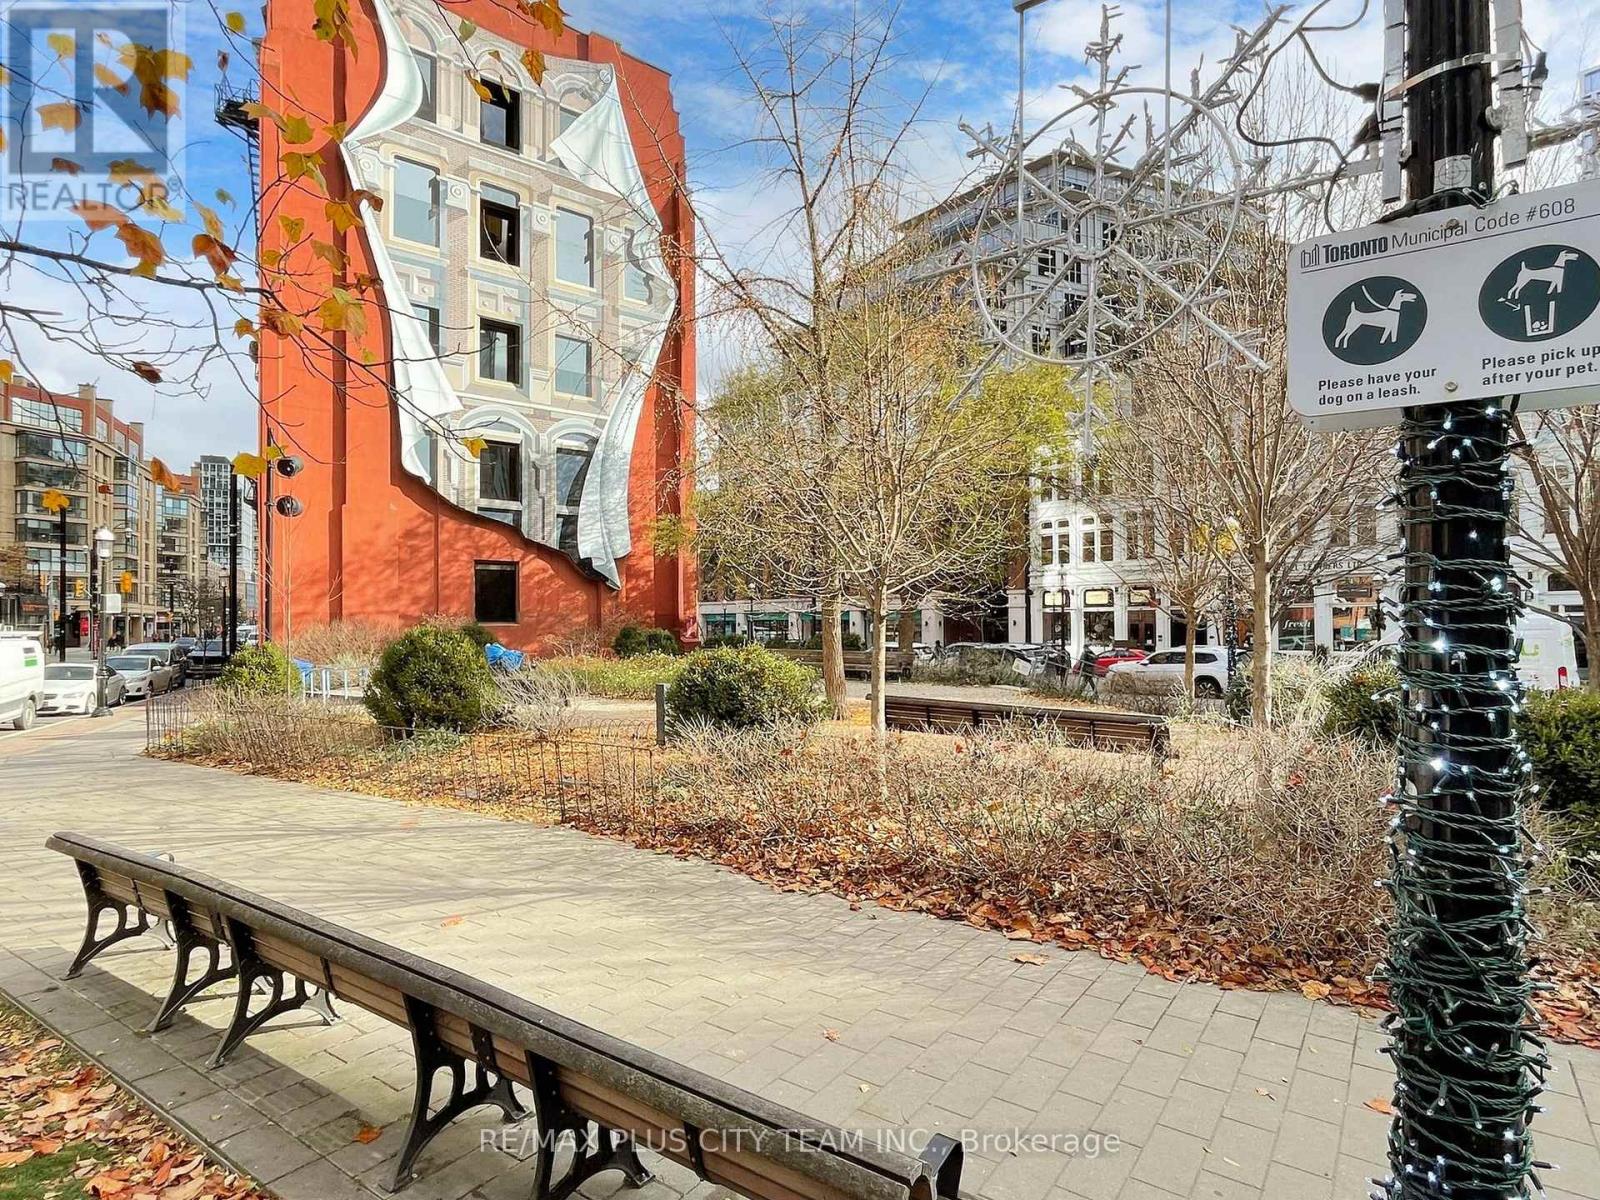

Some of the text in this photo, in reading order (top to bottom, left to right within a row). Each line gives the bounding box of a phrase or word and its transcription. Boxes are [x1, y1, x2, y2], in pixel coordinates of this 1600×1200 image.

[1322, 198, 1575, 264] TORONTO Municipal Code #608
[1482, 345, 1600, 370] Please pick up
[1318, 368, 1437, 391] Please have your
[1482, 362, 1598, 386] after your pet.
[1318, 384, 1421, 406] dog on a leash.
